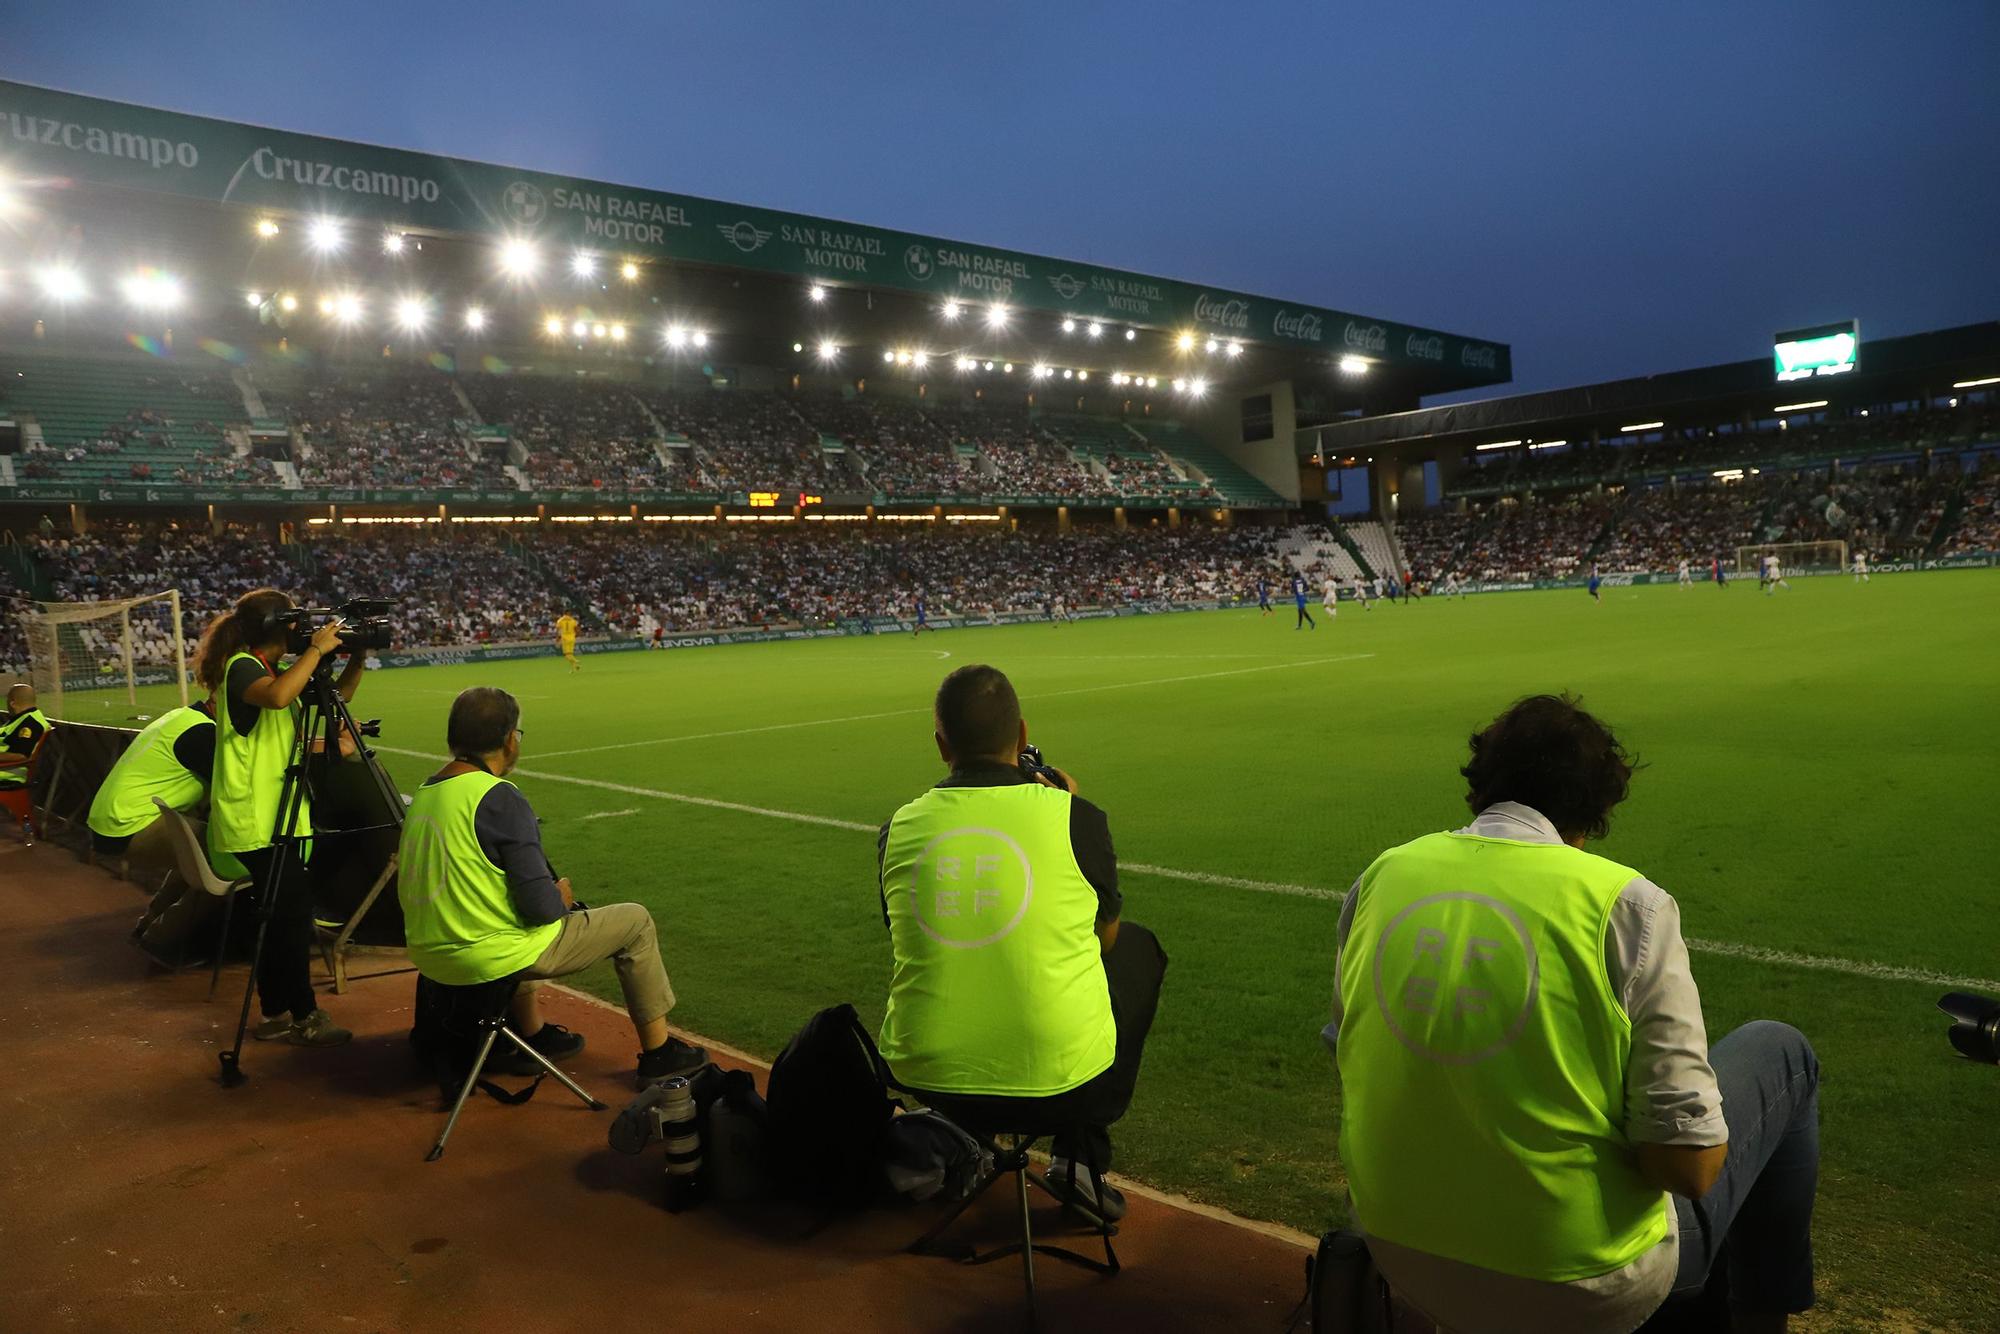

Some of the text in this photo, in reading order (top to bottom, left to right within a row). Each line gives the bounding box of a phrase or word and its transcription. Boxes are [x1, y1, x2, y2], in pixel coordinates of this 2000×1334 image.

[253, 146, 440, 204] Cruzcampo
[553, 188, 692, 227] SAN RAFAEL
[585, 215, 664, 244] MOTOR
[781, 224, 886, 256] SAN RAFAEL
[805, 247, 867, 272] MOTOR
[937, 249, 1032, 279] SAN RAFAEL
[958, 271, 1012, 294] MOTOR
[1091, 274, 1115, 291] SAN
[1118, 279, 1163, 301] RAFAEL
[1108, 295, 1150, 314] MOTOR
